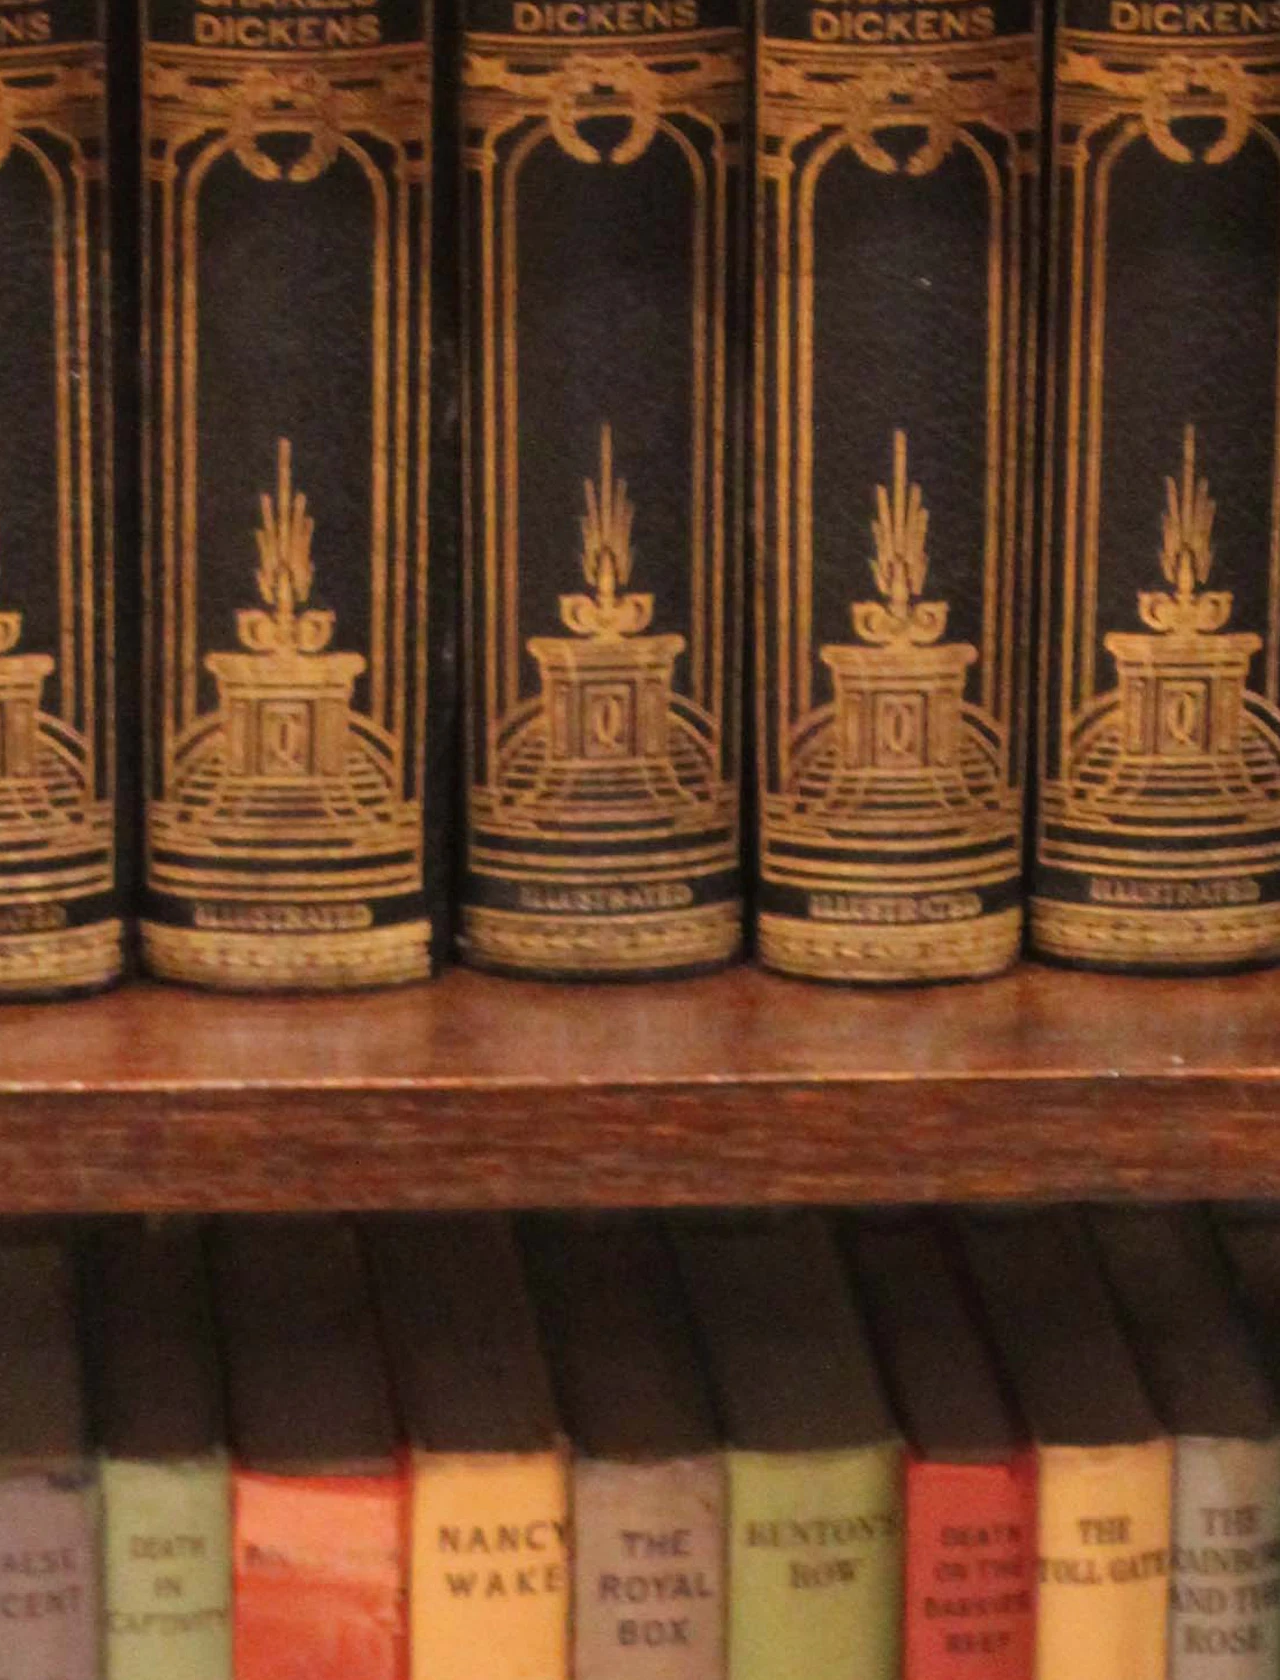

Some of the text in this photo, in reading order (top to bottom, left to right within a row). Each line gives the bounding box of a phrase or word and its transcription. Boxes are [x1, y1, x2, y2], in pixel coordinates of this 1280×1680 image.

[194, 12, 382, 46] DICKENS
[811, 4, 995, 42] DICKENS
[438, 1520, 570, 1555] NANCY
[1078, 1516, 1131, 1546] THE
[1198, 1506, 1256, 1537] THE
[130, 1534, 208, 1561] DEATH
[620, 1528, 694, 1559] THE
[445, 1566, 564, 1599] WAKE
[1040, 1549, 1169, 1584] TOLL GATE
[598, 1571, 714, 1604] ROYAL
[618, 1619, 691, 1648] BOX
[1183, 1624, 1262, 1655] ROSE
